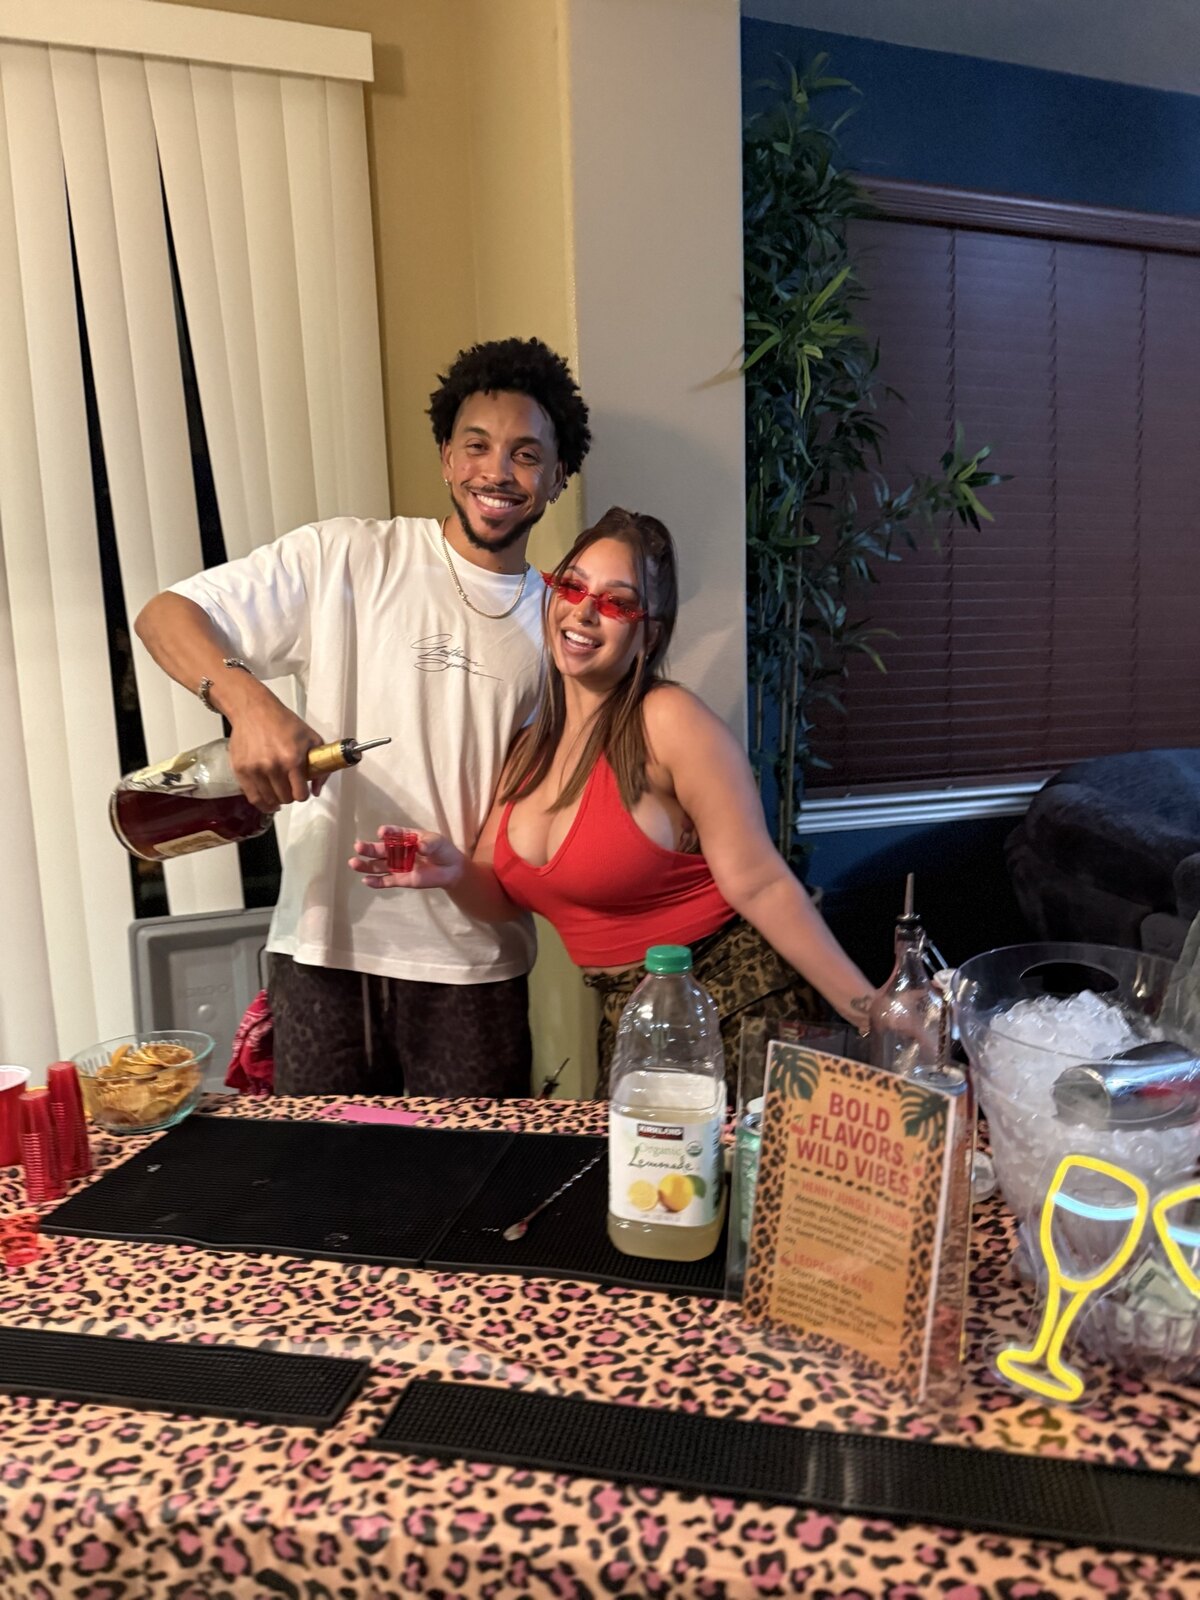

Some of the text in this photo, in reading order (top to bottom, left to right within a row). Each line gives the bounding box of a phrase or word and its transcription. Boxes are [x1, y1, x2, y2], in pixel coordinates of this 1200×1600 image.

[829, 1091, 890, 1132] BOLD
[638, 1125, 682, 1136] KIRKLAND
[809, 1113, 908, 1168] FLAVORS.
[627, 1145, 694, 1171] Lemonade
[796, 1137, 849, 1172] WILD
